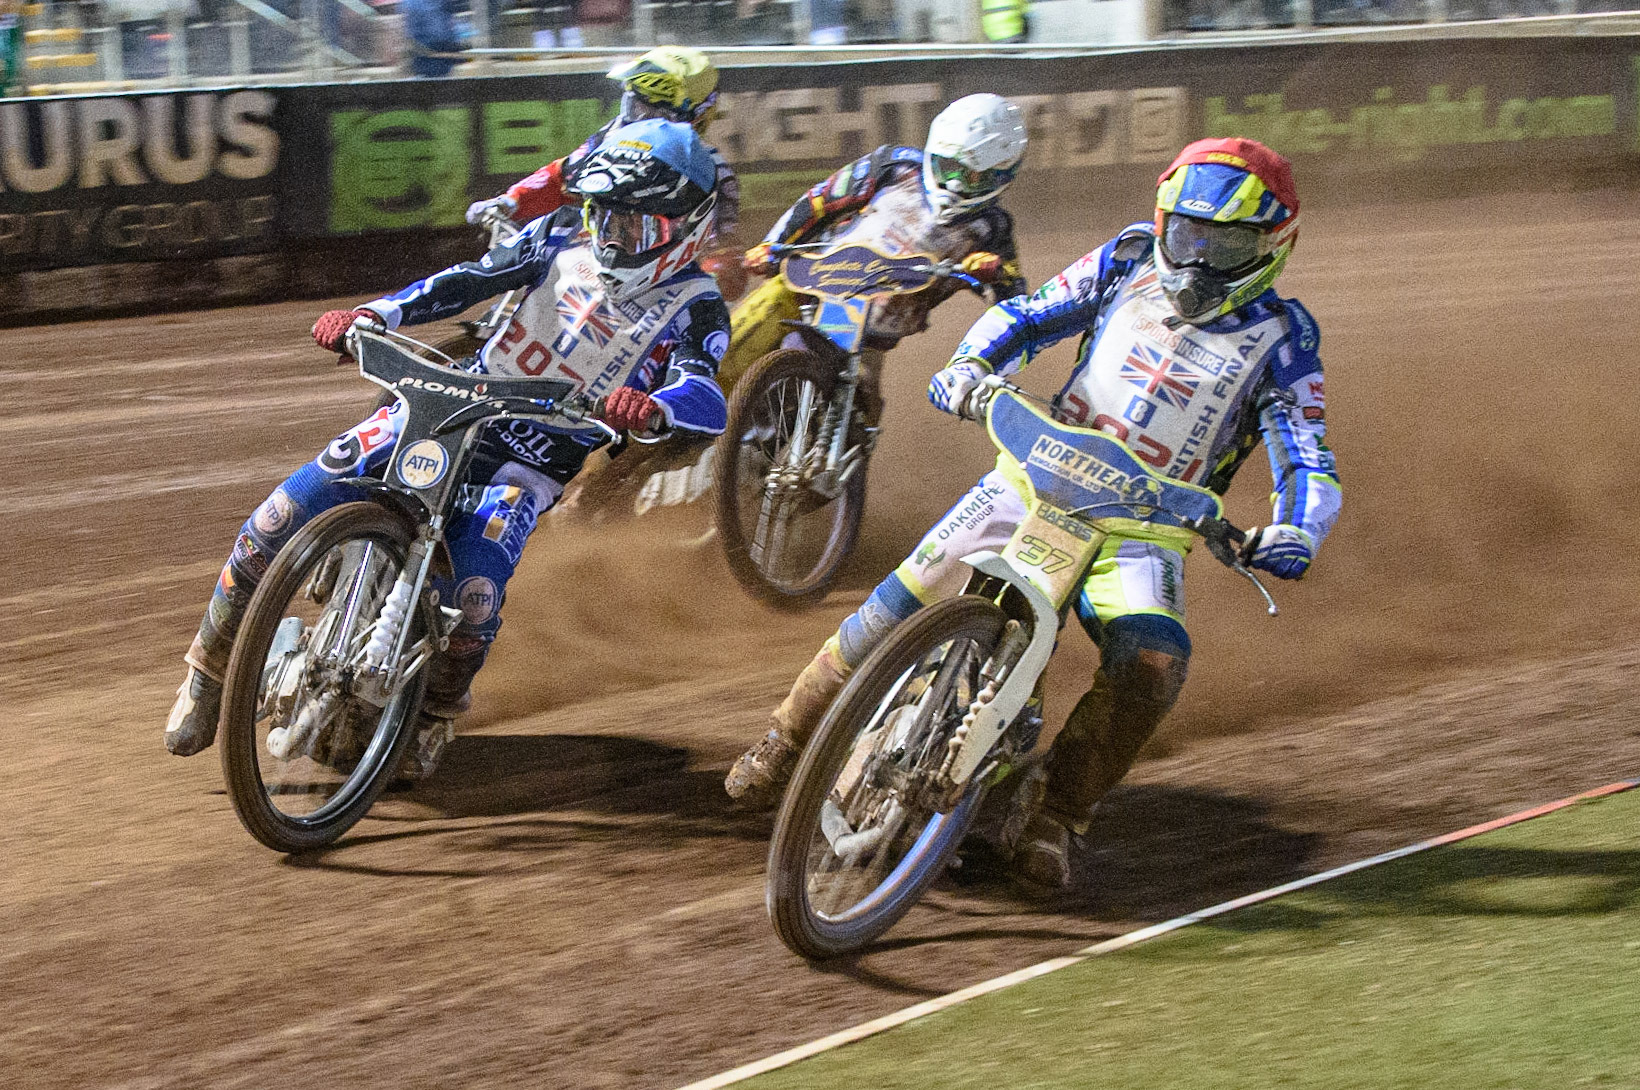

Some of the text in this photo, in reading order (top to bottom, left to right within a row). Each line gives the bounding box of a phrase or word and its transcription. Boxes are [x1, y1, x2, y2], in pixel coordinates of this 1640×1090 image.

[0, 92, 281, 193] URUS
[632, 288, 684, 345] FINAL
[1135, 316, 1226, 374] SPORTS INSURE
[1130, 401, 1146, 423] 8
[1165, 330, 1266, 479] RITISH FINAL
[405, 454, 439, 473] ATPI
[966, 504, 996, 531] GROUP
[1016, 535, 1075, 575] 37
